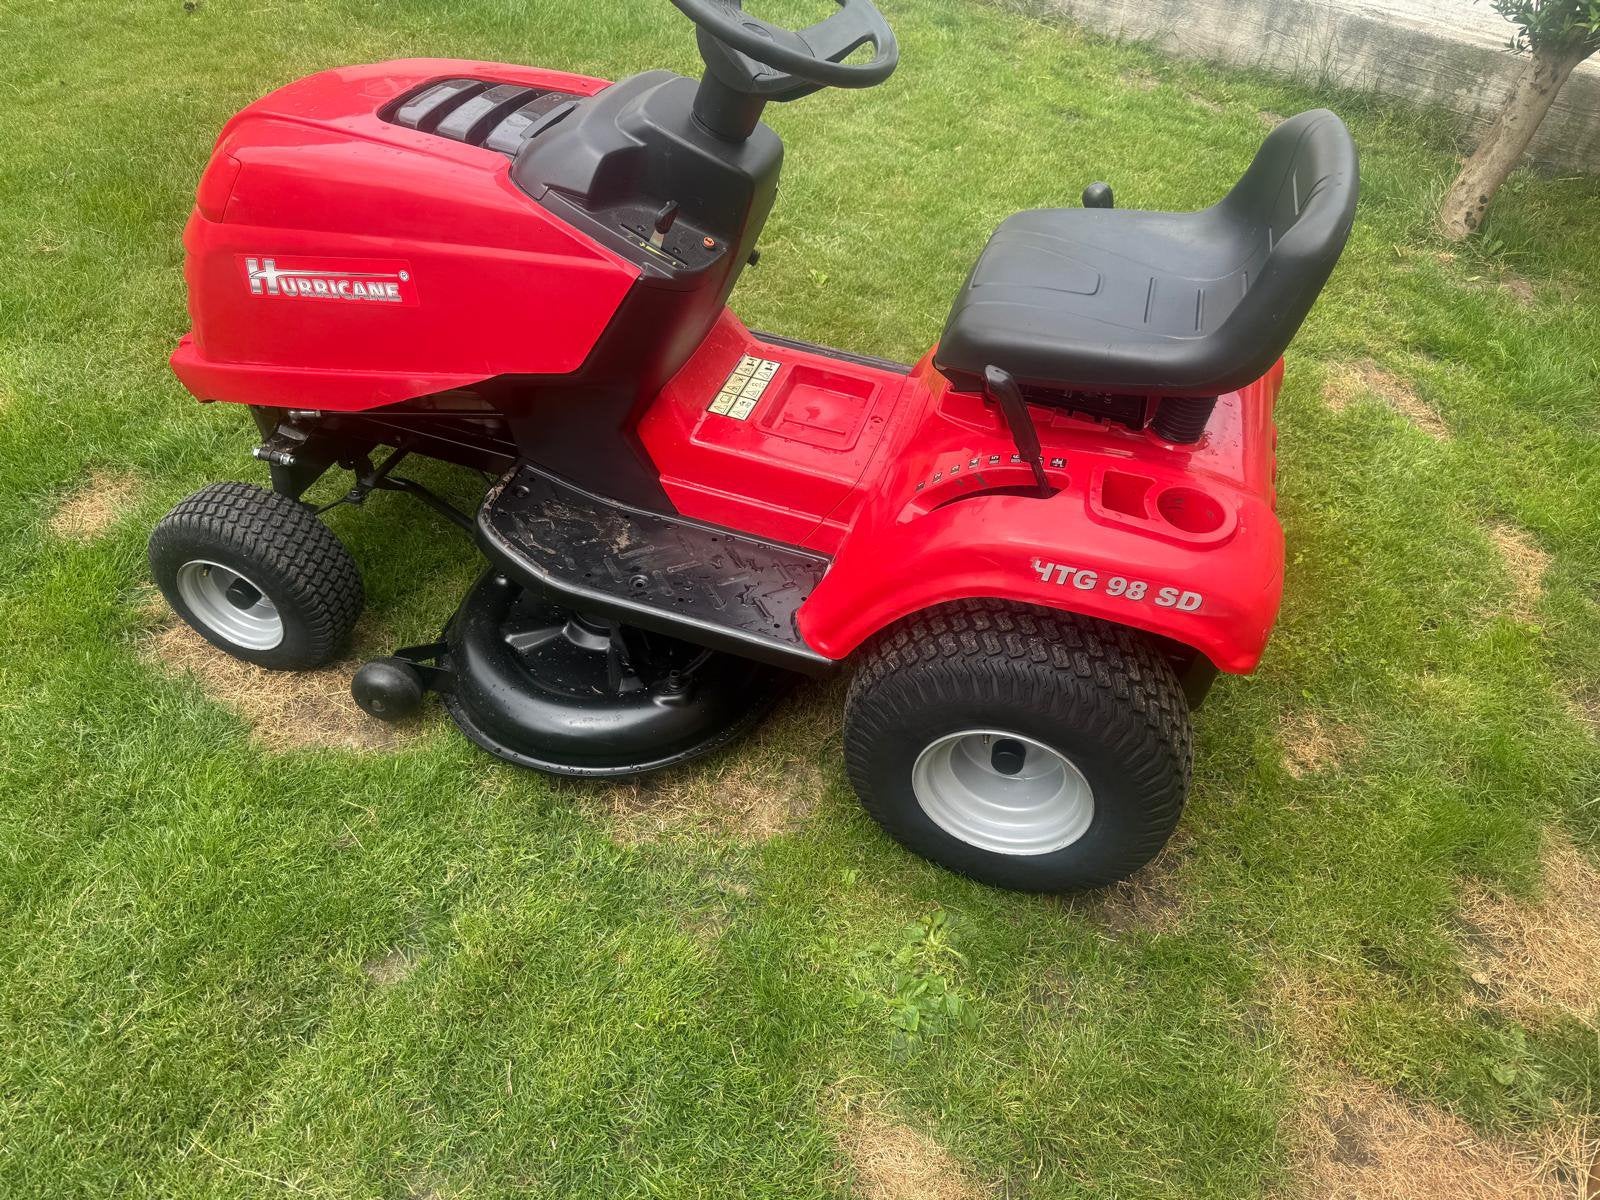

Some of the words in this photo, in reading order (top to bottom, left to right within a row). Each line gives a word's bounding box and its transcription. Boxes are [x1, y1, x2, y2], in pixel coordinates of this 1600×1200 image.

[246, 258, 402, 302] HURRICANE
[1105, 576, 1148, 601] 98
[1154, 587, 1203, 611] SD
